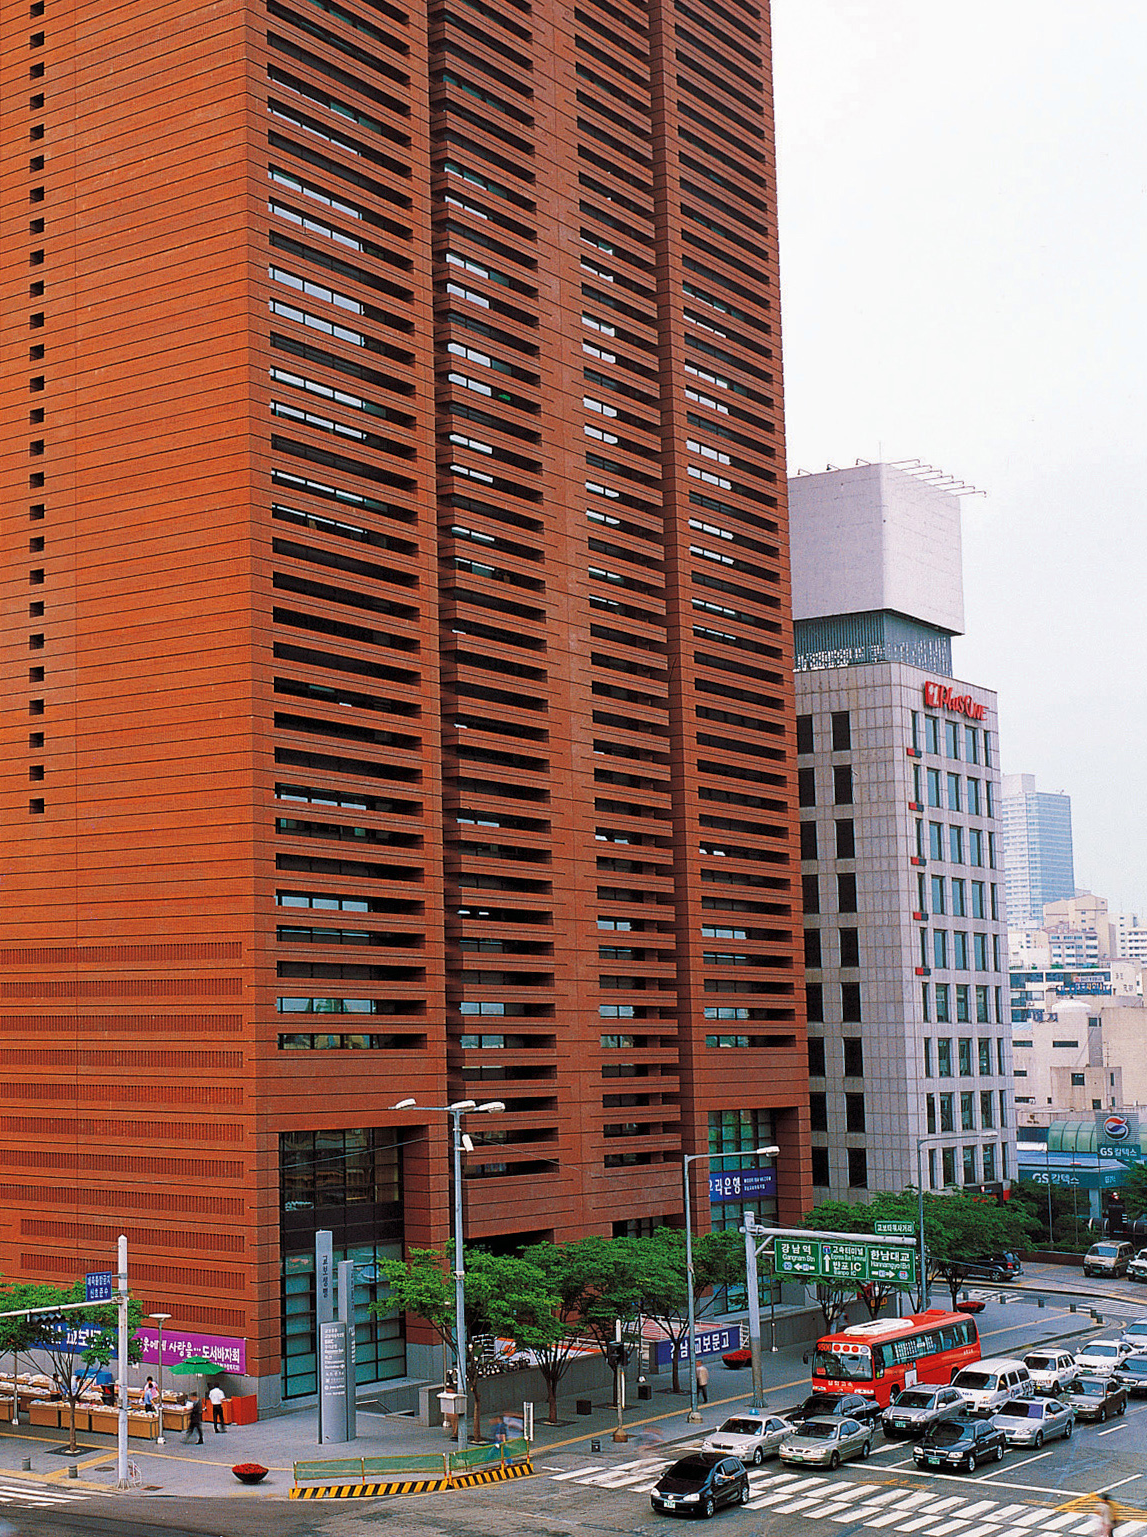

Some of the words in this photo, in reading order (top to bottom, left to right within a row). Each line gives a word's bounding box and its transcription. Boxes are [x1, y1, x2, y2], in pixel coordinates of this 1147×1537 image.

[782, 1243, 812, 1255] 강남역
[832, 1246, 864, 1255] 고속터미널
[871, 1250, 910, 1262] 한남대교
[833, 1261, 849, 1270] 반포
[850, 1262, 862, 1272] IC
[694, 1331, 730, 1355] 교보문고
[136, 1336, 167, 1353] 웃에게
[202, 1345, 240, 1363] 도서바자회
